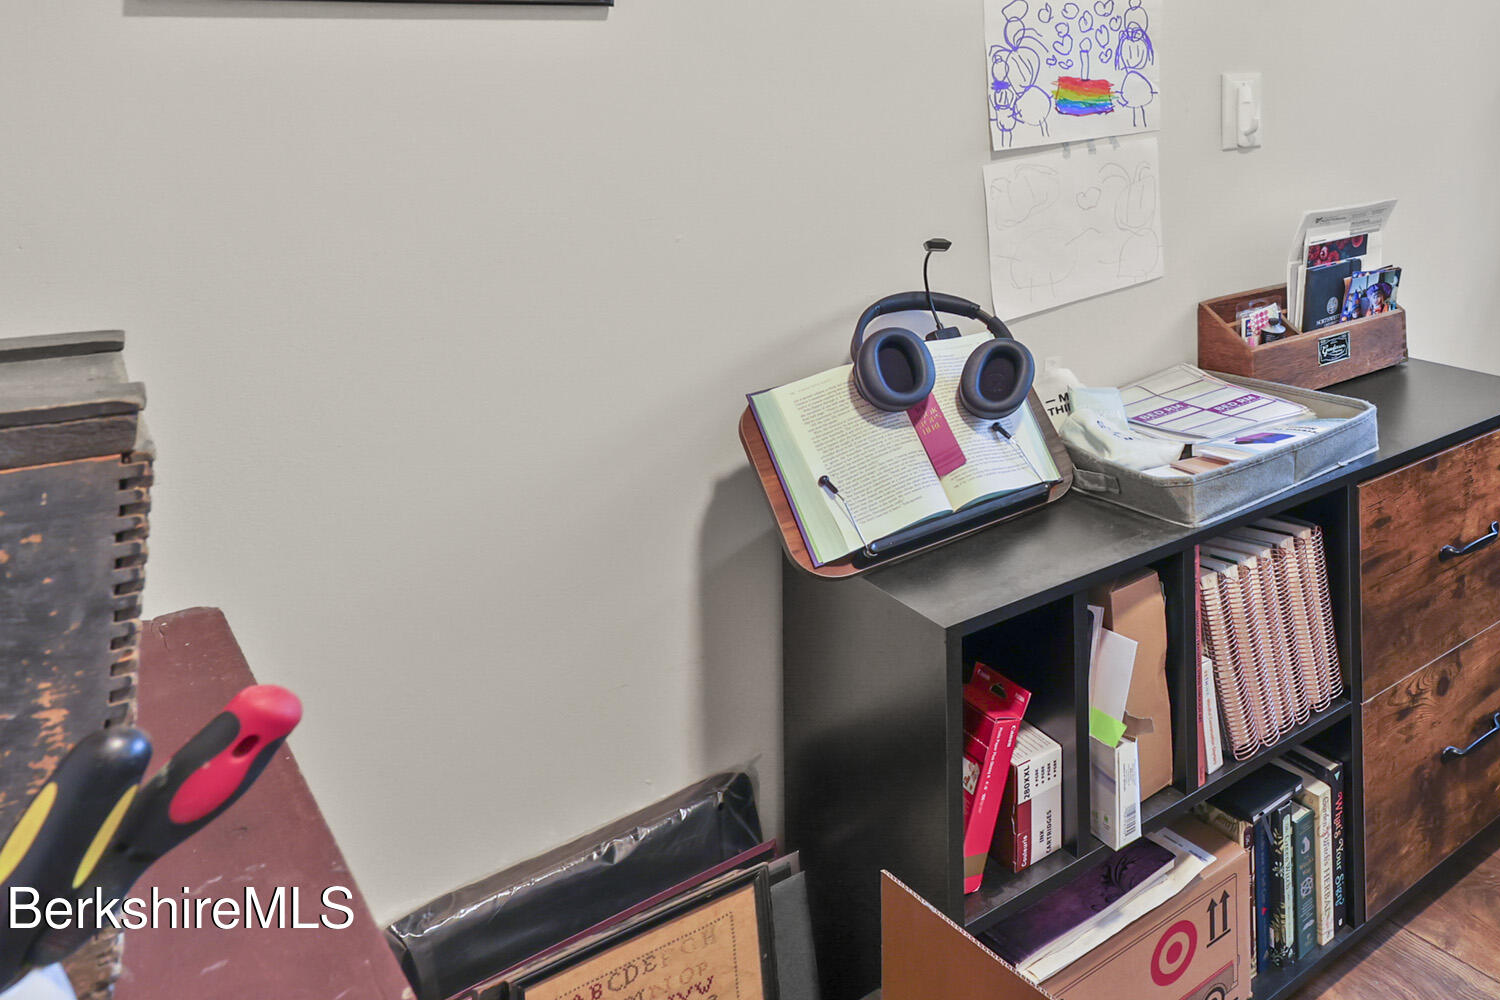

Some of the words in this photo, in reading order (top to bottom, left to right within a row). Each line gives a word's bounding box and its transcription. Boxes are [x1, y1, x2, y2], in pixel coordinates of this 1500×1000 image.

[1334, 791, 1344, 838] What's
[1336, 838, 1344, 871] Your
[1323, 867, 1331, 916] HERBAL
[1335, 873, 1345, 907] Sign?
